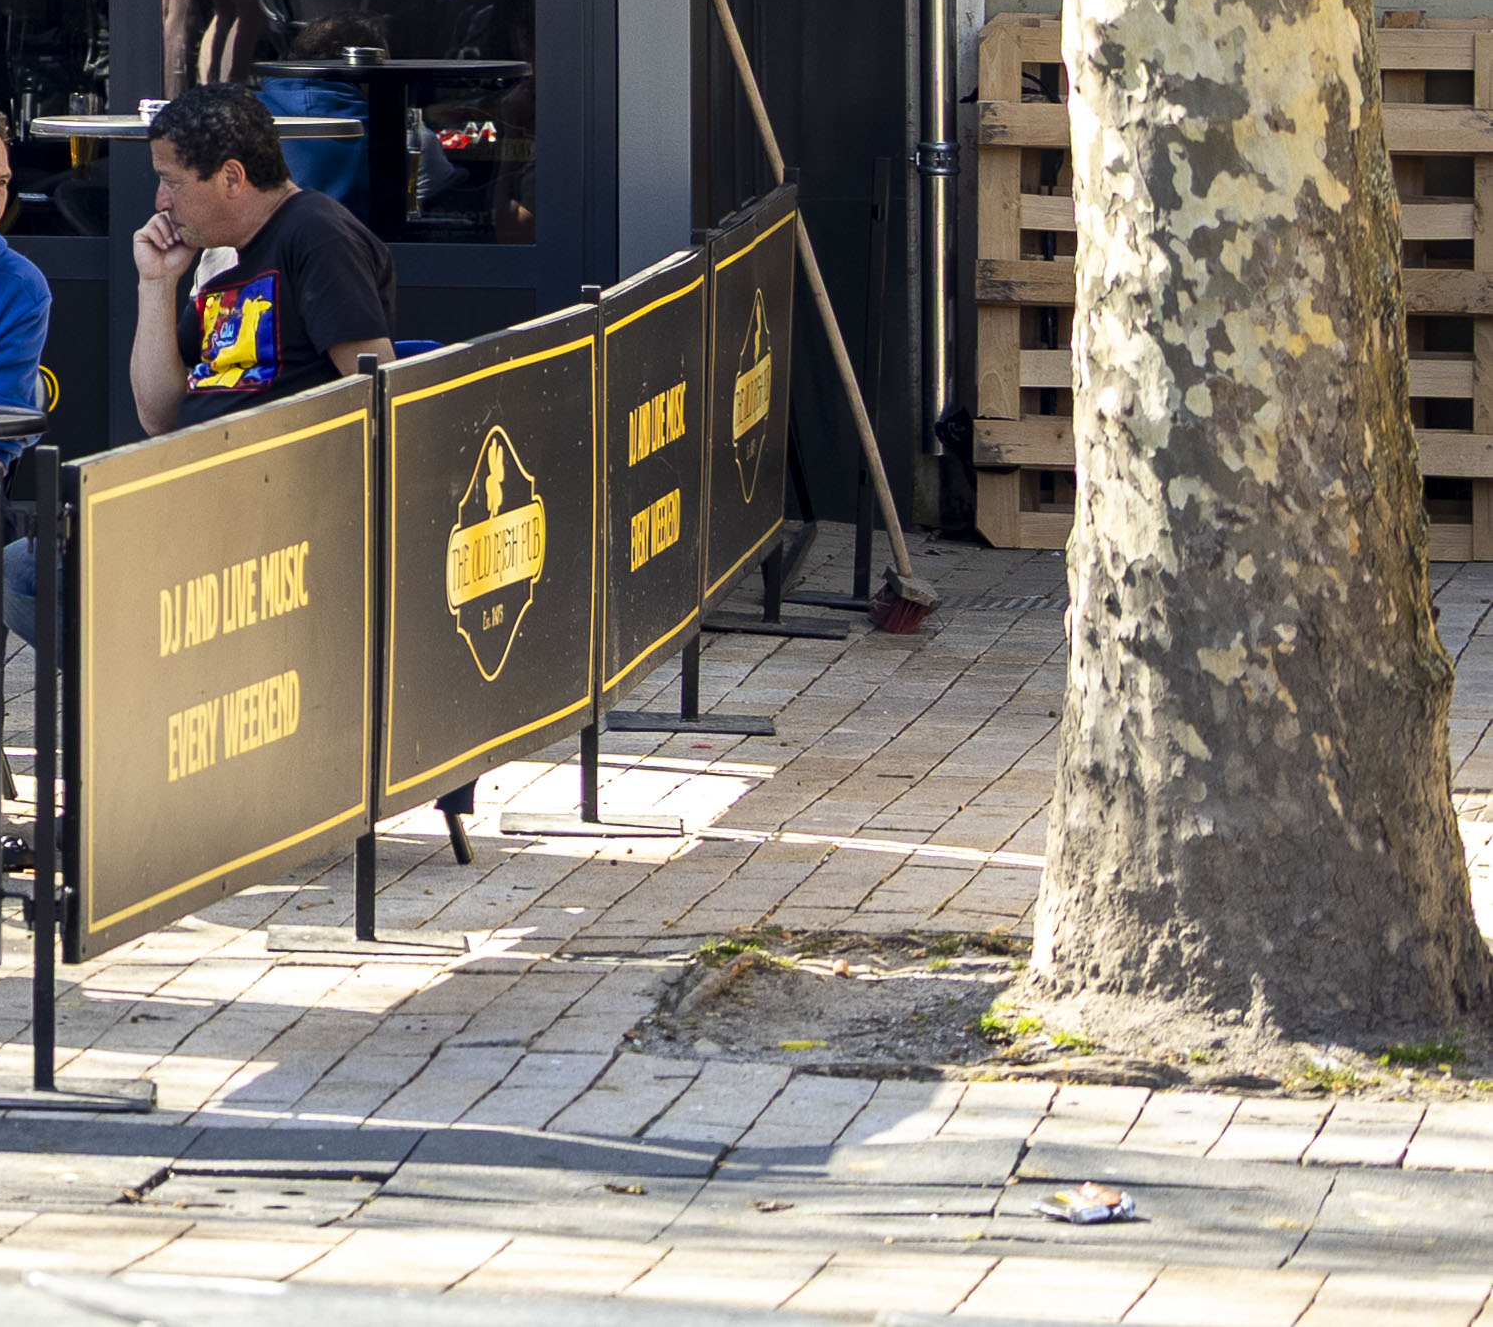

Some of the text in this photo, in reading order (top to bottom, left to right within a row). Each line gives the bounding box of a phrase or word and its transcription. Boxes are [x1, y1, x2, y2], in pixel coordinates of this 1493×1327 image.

[159, 540, 310, 659] DJ AND LIVE MUSIC
[451, 516, 541, 594] THE OLD IRISH PUB
[168, 668, 301, 784] EVERY WEEKEND
